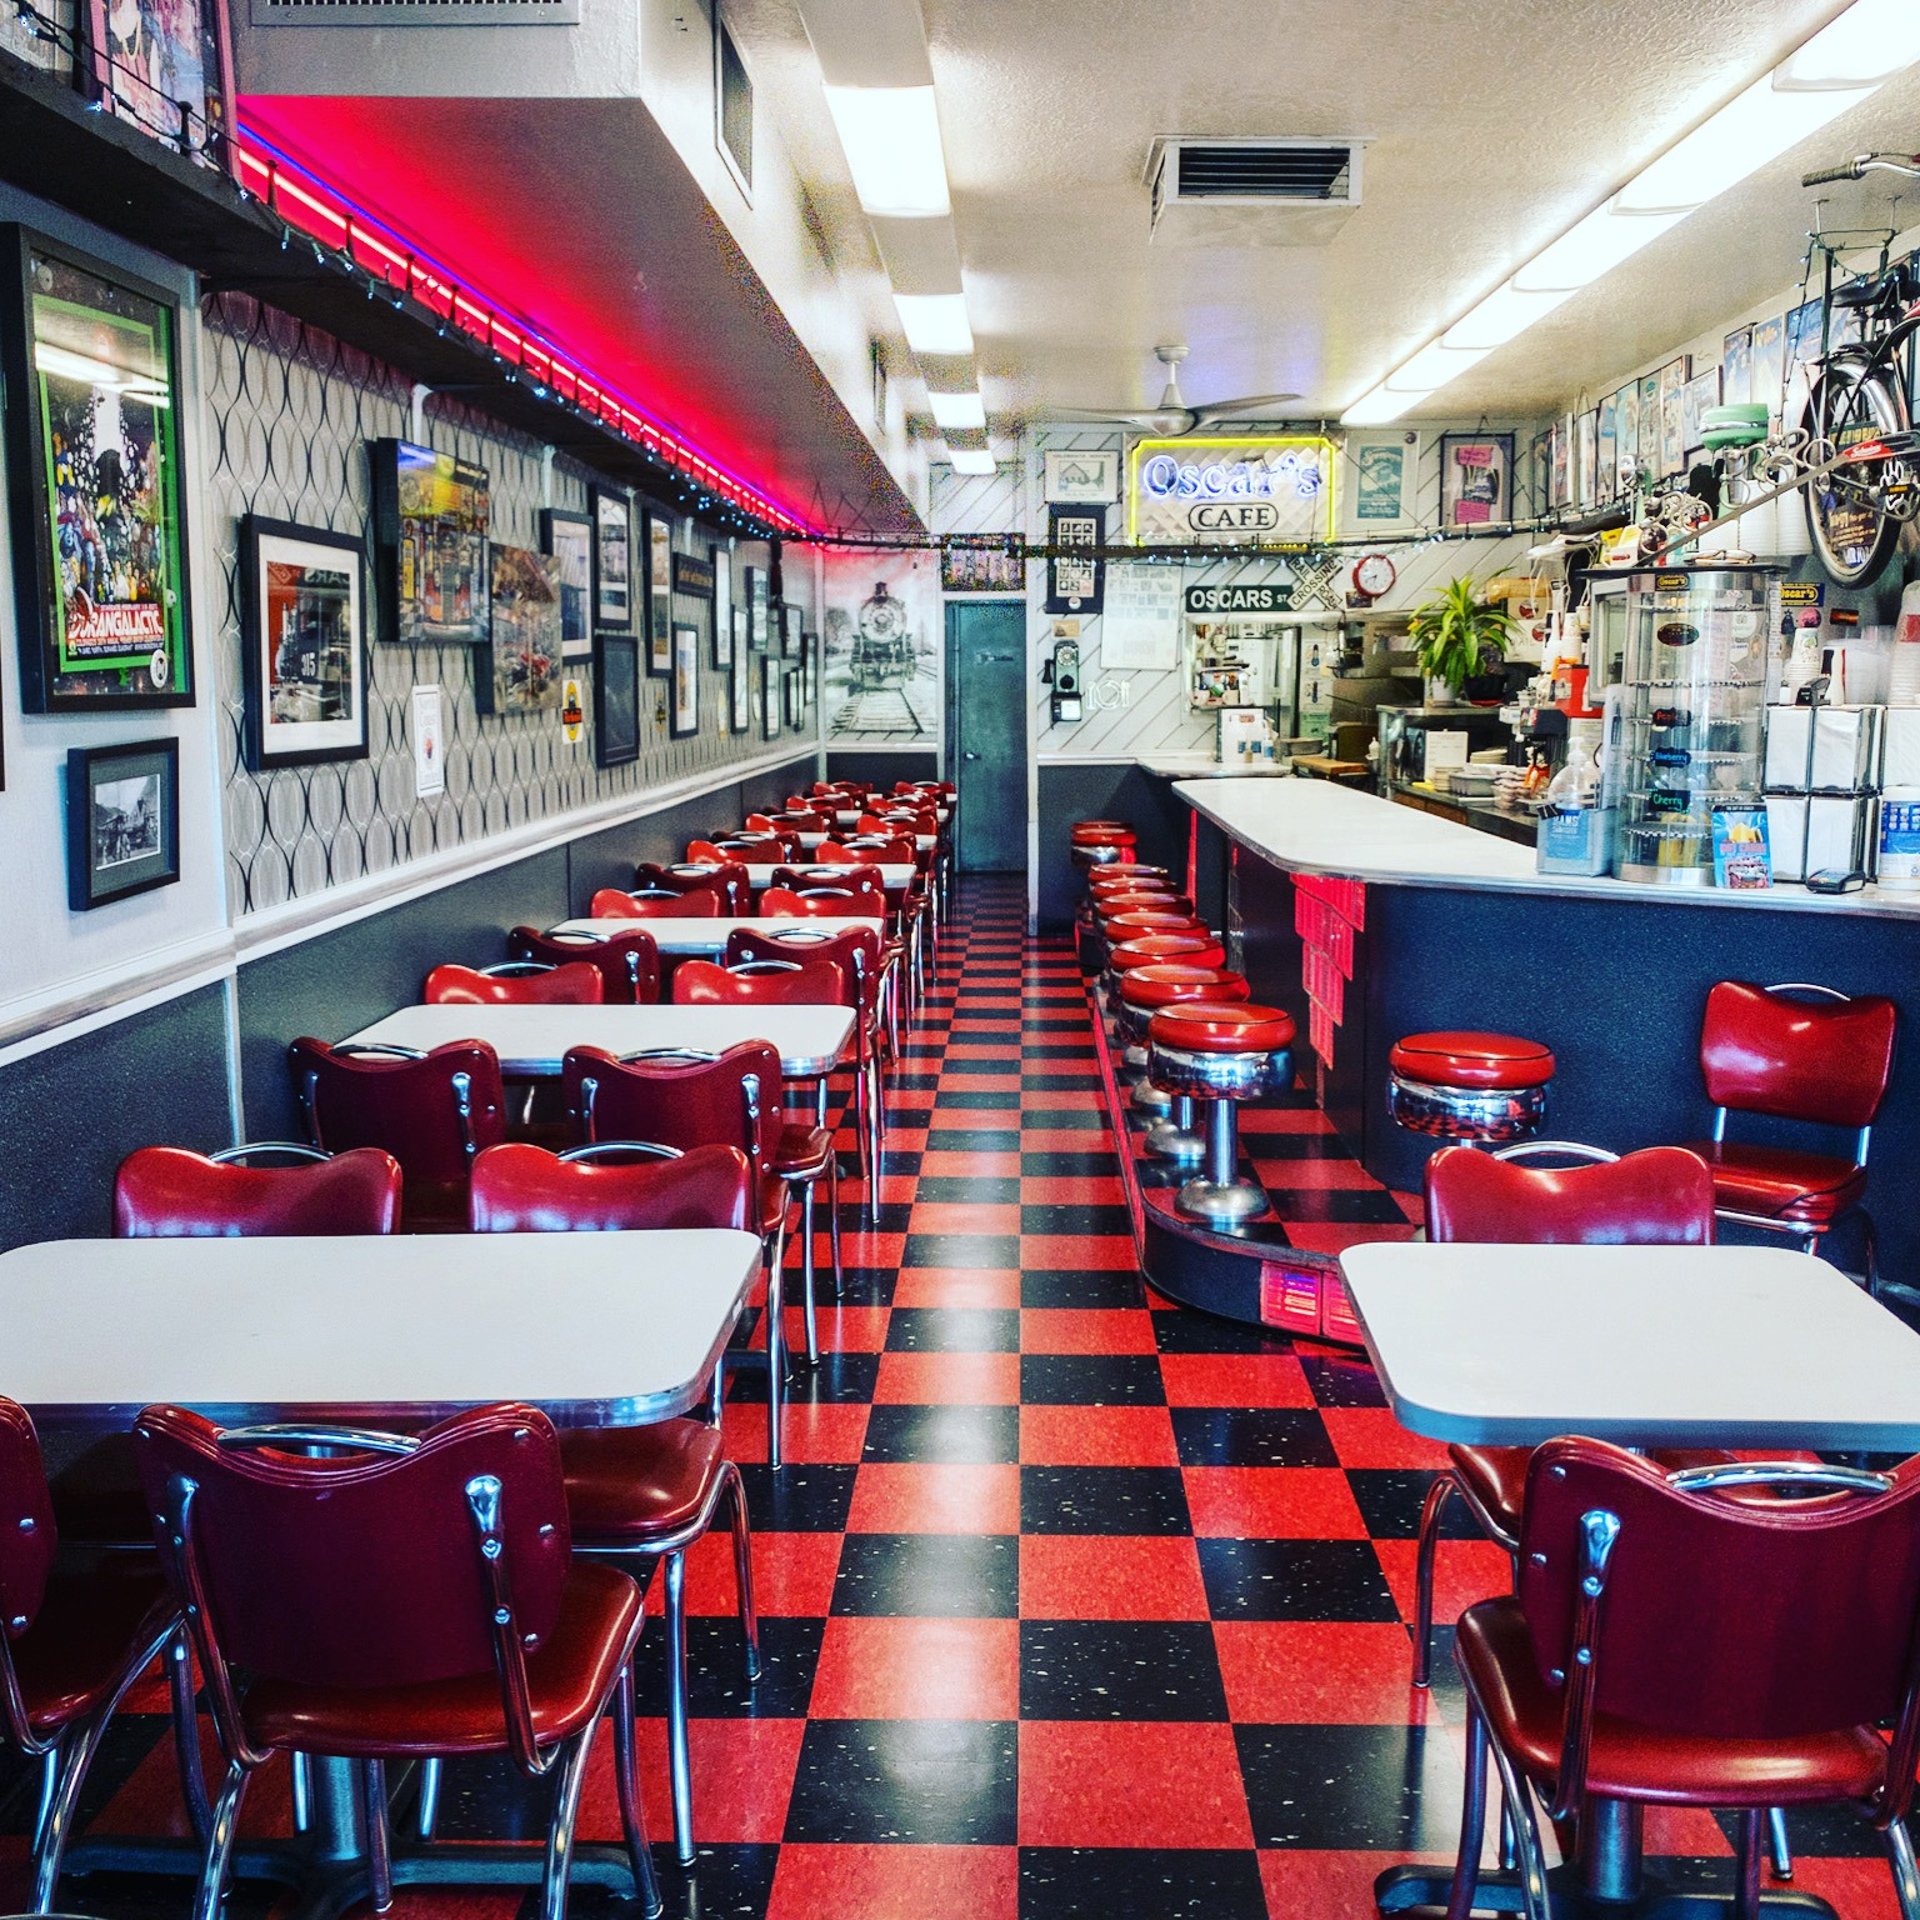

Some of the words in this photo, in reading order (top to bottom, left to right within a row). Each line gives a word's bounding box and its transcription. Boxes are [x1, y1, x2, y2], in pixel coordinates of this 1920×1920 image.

[1142, 453, 1321, 497] Oscar's
[1197, 507, 1270, 526] CAFE
[1292, 558, 1311, 580] RAIL
[1291, 560, 1339, 606] CROSSING
[1190, 589, 1273, 609] OSCARS
[1653, 793, 1683, 811] Cherry
